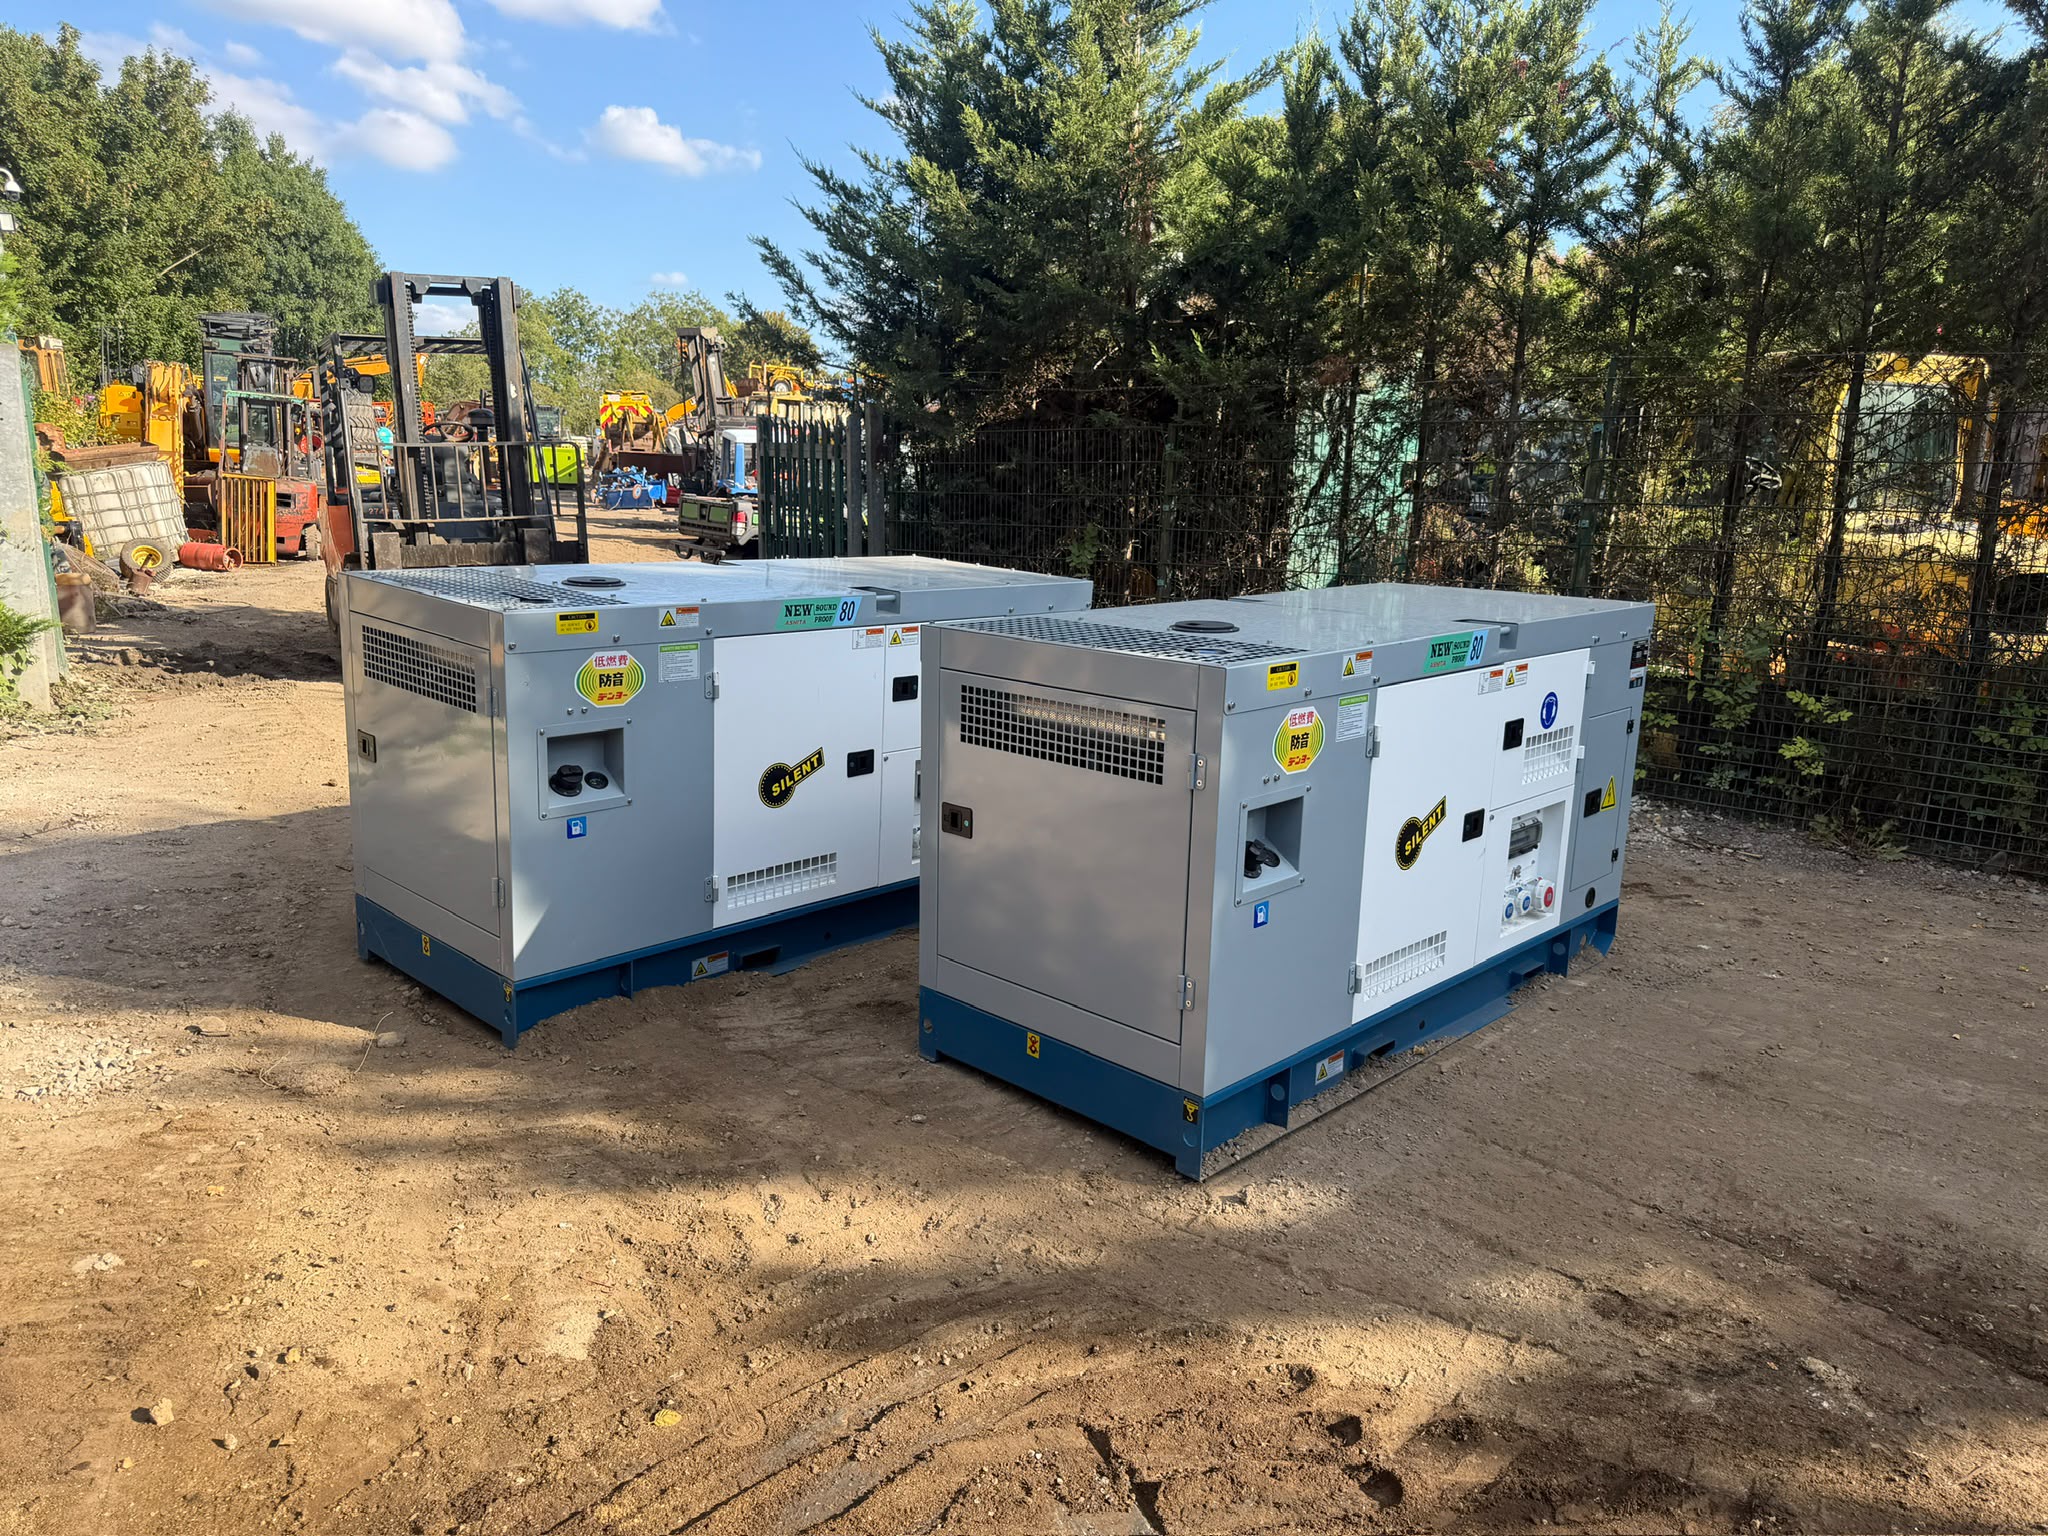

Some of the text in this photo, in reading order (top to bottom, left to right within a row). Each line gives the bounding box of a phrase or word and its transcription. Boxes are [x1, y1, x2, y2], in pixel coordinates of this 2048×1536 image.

[784, 604, 814, 617] NEW
[815, 603, 838, 612] SOUND
[839, 601, 856, 622] 80
[1430, 641, 1454, 658] NEW
[1470, 635, 1484, 661] 80
[594, 655, 629, 668] 低燃費
[599, 672, 624, 688] 防音
[597, 691, 628, 701] デンヨー
[1290, 732, 1310, 751] 防音
[1287, 754, 1311, 767] デンヨー
[772, 754, 819, 797] SILENT
[1405, 804, 1443, 856] SILENT
